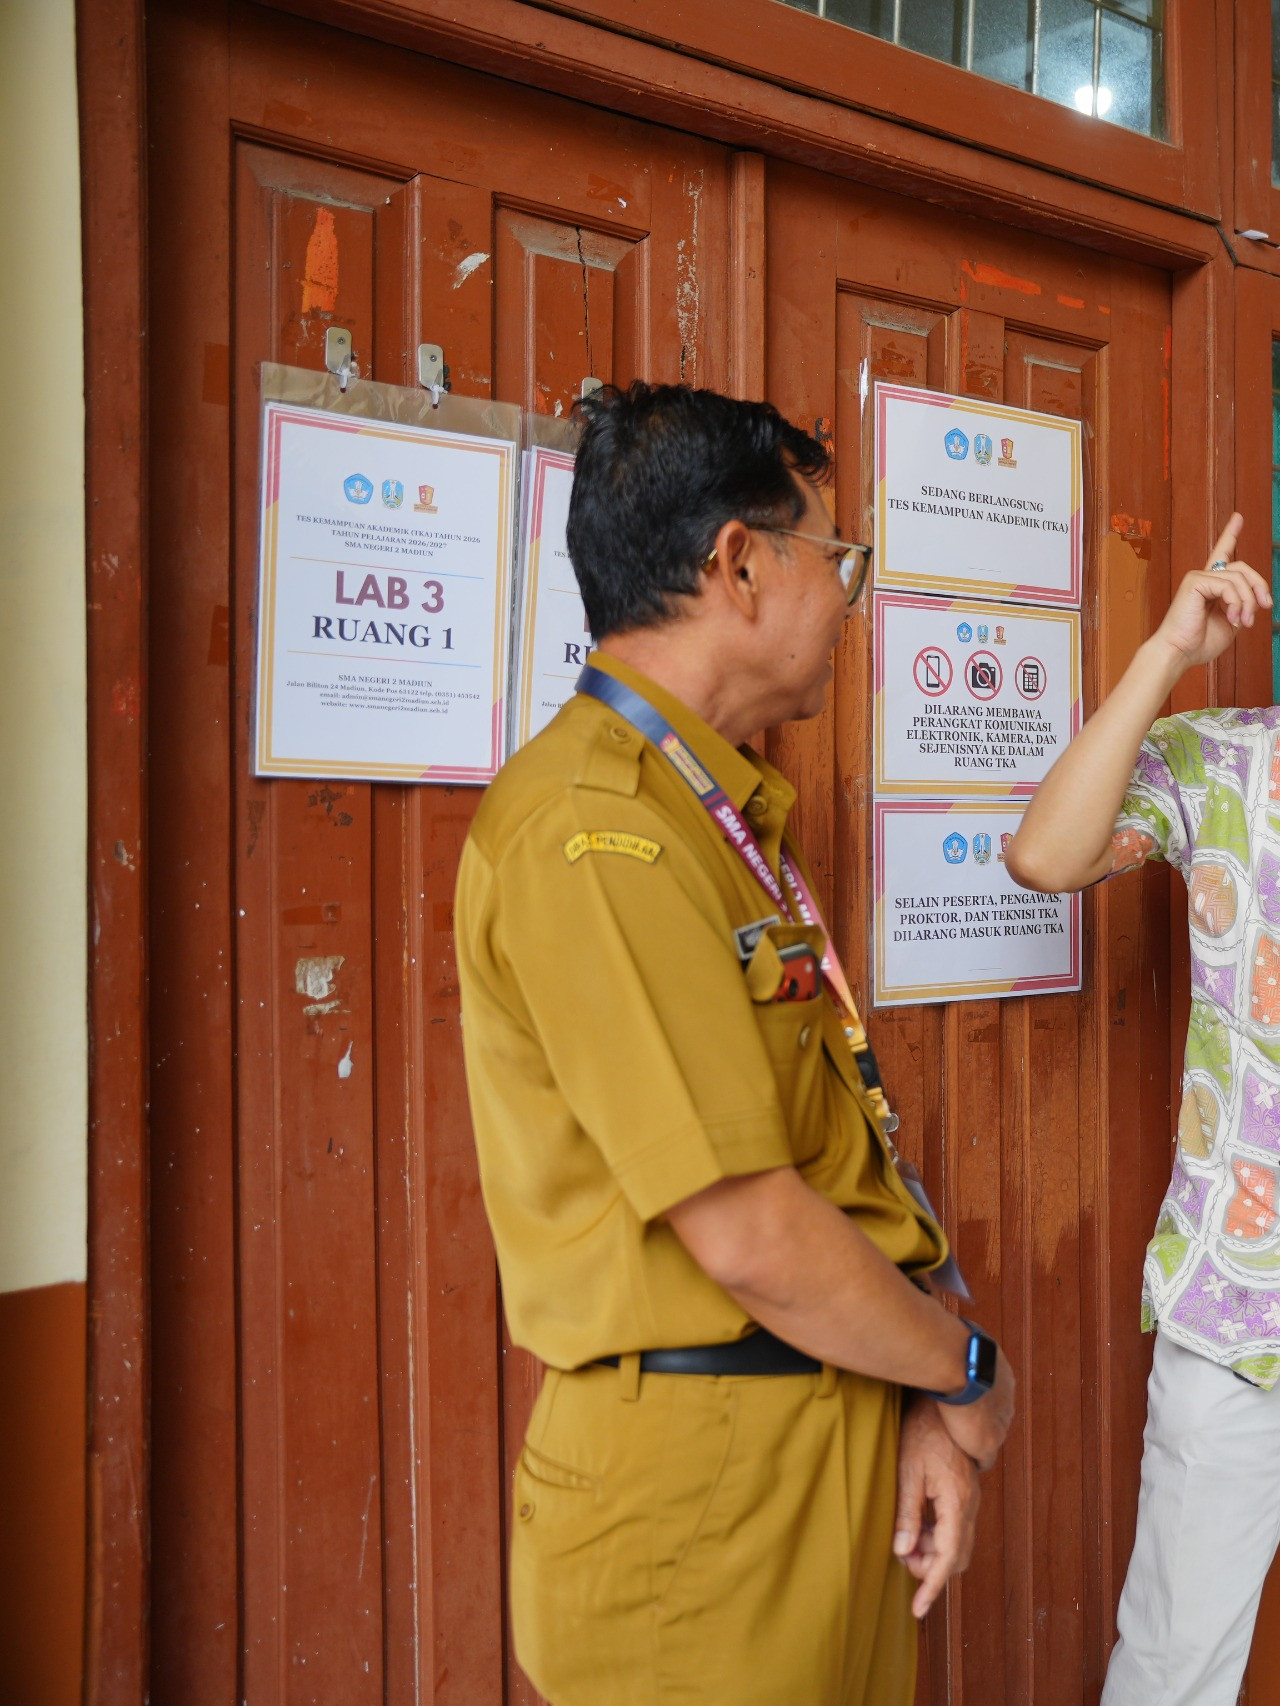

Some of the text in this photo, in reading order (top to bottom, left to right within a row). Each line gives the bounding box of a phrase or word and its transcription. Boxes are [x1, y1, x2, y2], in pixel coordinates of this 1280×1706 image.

[921, 485, 1044, 512] SEDANG BERLANGSUNG
[888, 498, 1068, 534] TES KEMAMPUAN AKADEMIK (TKA)
[296, 514, 481, 544] TES KEMAMPUAN AKADEMIK (TKA) TAHUN 2026
[332, 530, 447, 549] TAHUN PELAJARAN 2026/2027
[344, 541, 434, 556] SMA NEGERI 2 MADIUN
[336, 570, 444, 614] LAB 3
[312, 616, 455, 650] RUANG 1
[338, 674, 356, 682] SMA
[358, 676, 390, 684] NEGERI
[399, 680, 432, 688] MADIUN
[321, 700, 348, 708] website:
[924, 704, 1042, 720] DILARANG MEMBAWA
[912, 716, 1052, 732] PERANGKAT KOMUNIKASI
[906, 730, 1058, 746] ELEKTRONIK, KAMERA, DAN
[919, 743, 1044, 756] SEJENISNYA KE DALAM
[954, 756, 1016, 768] RUANG TKA
[716, 804, 747, 844] SMA
[894, 893, 1062, 909] SELAIN PESERTA, PENGAWAS,
[900, 908, 1058, 925] PROKTOR, DAN TEKNISI TKA
[894, 924, 1064, 942] DILARANG MASUK RUANG TKA
